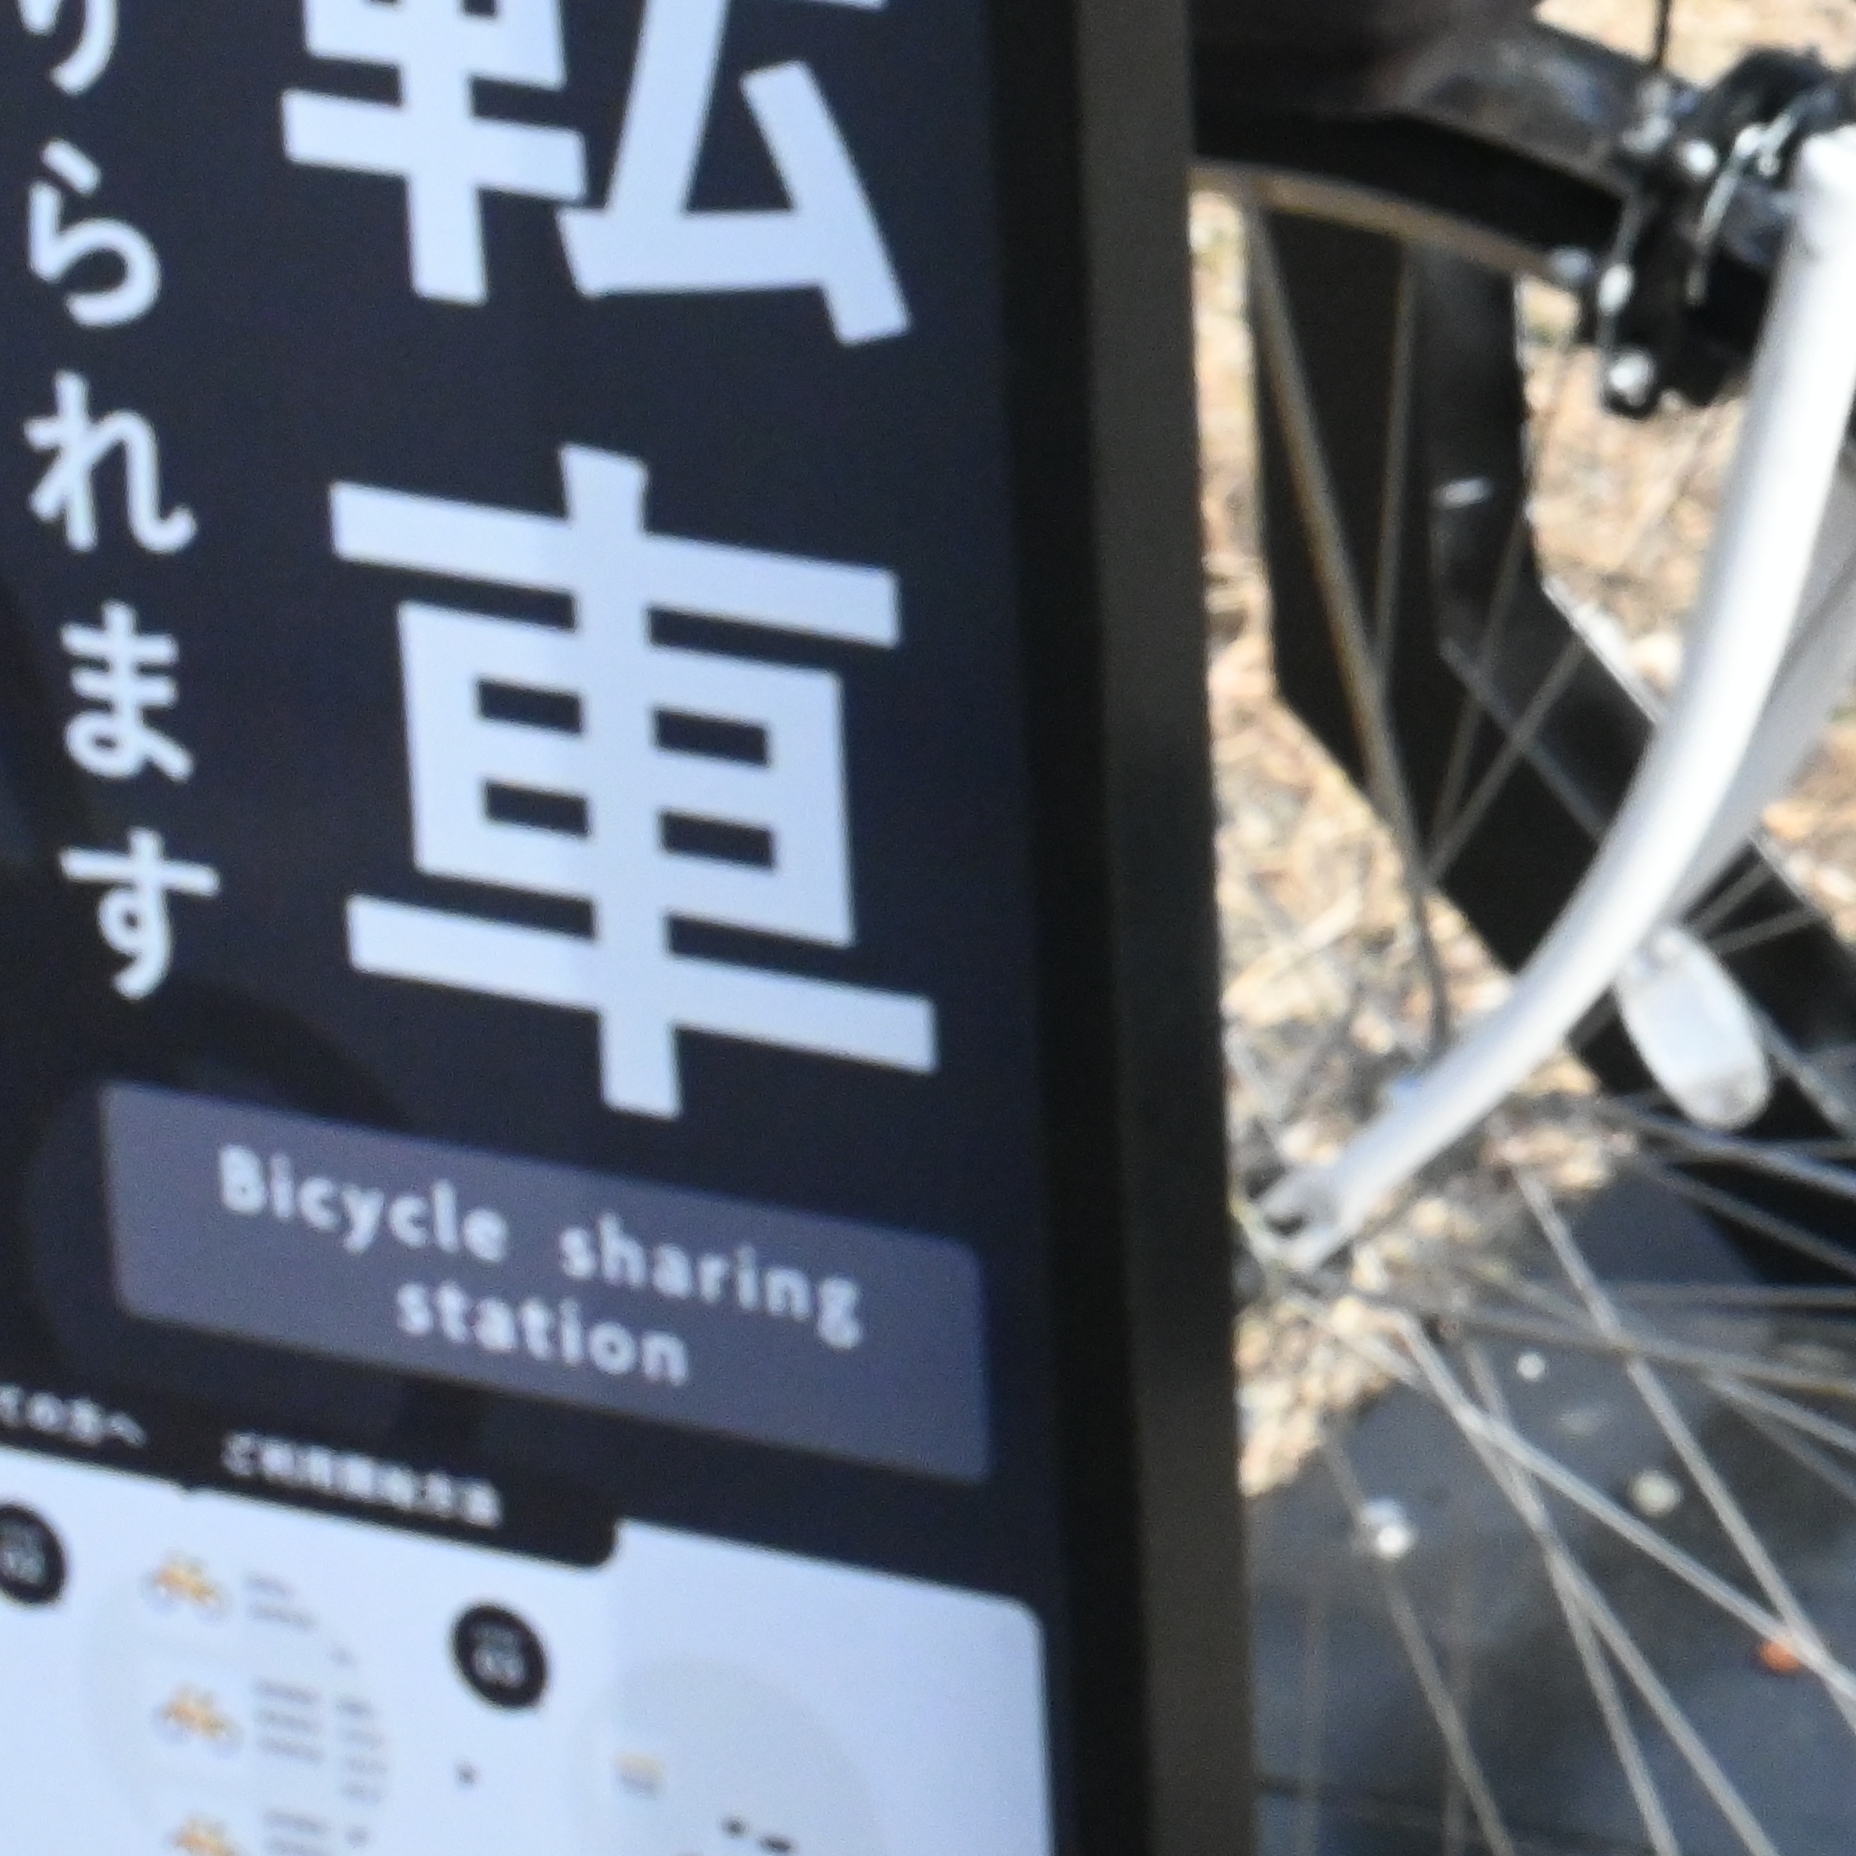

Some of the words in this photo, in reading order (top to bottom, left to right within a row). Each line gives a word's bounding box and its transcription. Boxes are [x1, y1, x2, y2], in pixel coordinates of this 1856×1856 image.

[216, 1141, 511, 1265] Bicycle
[558, 1212, 864, 1351] sharing
[396, 1278, 691, 1388] station
